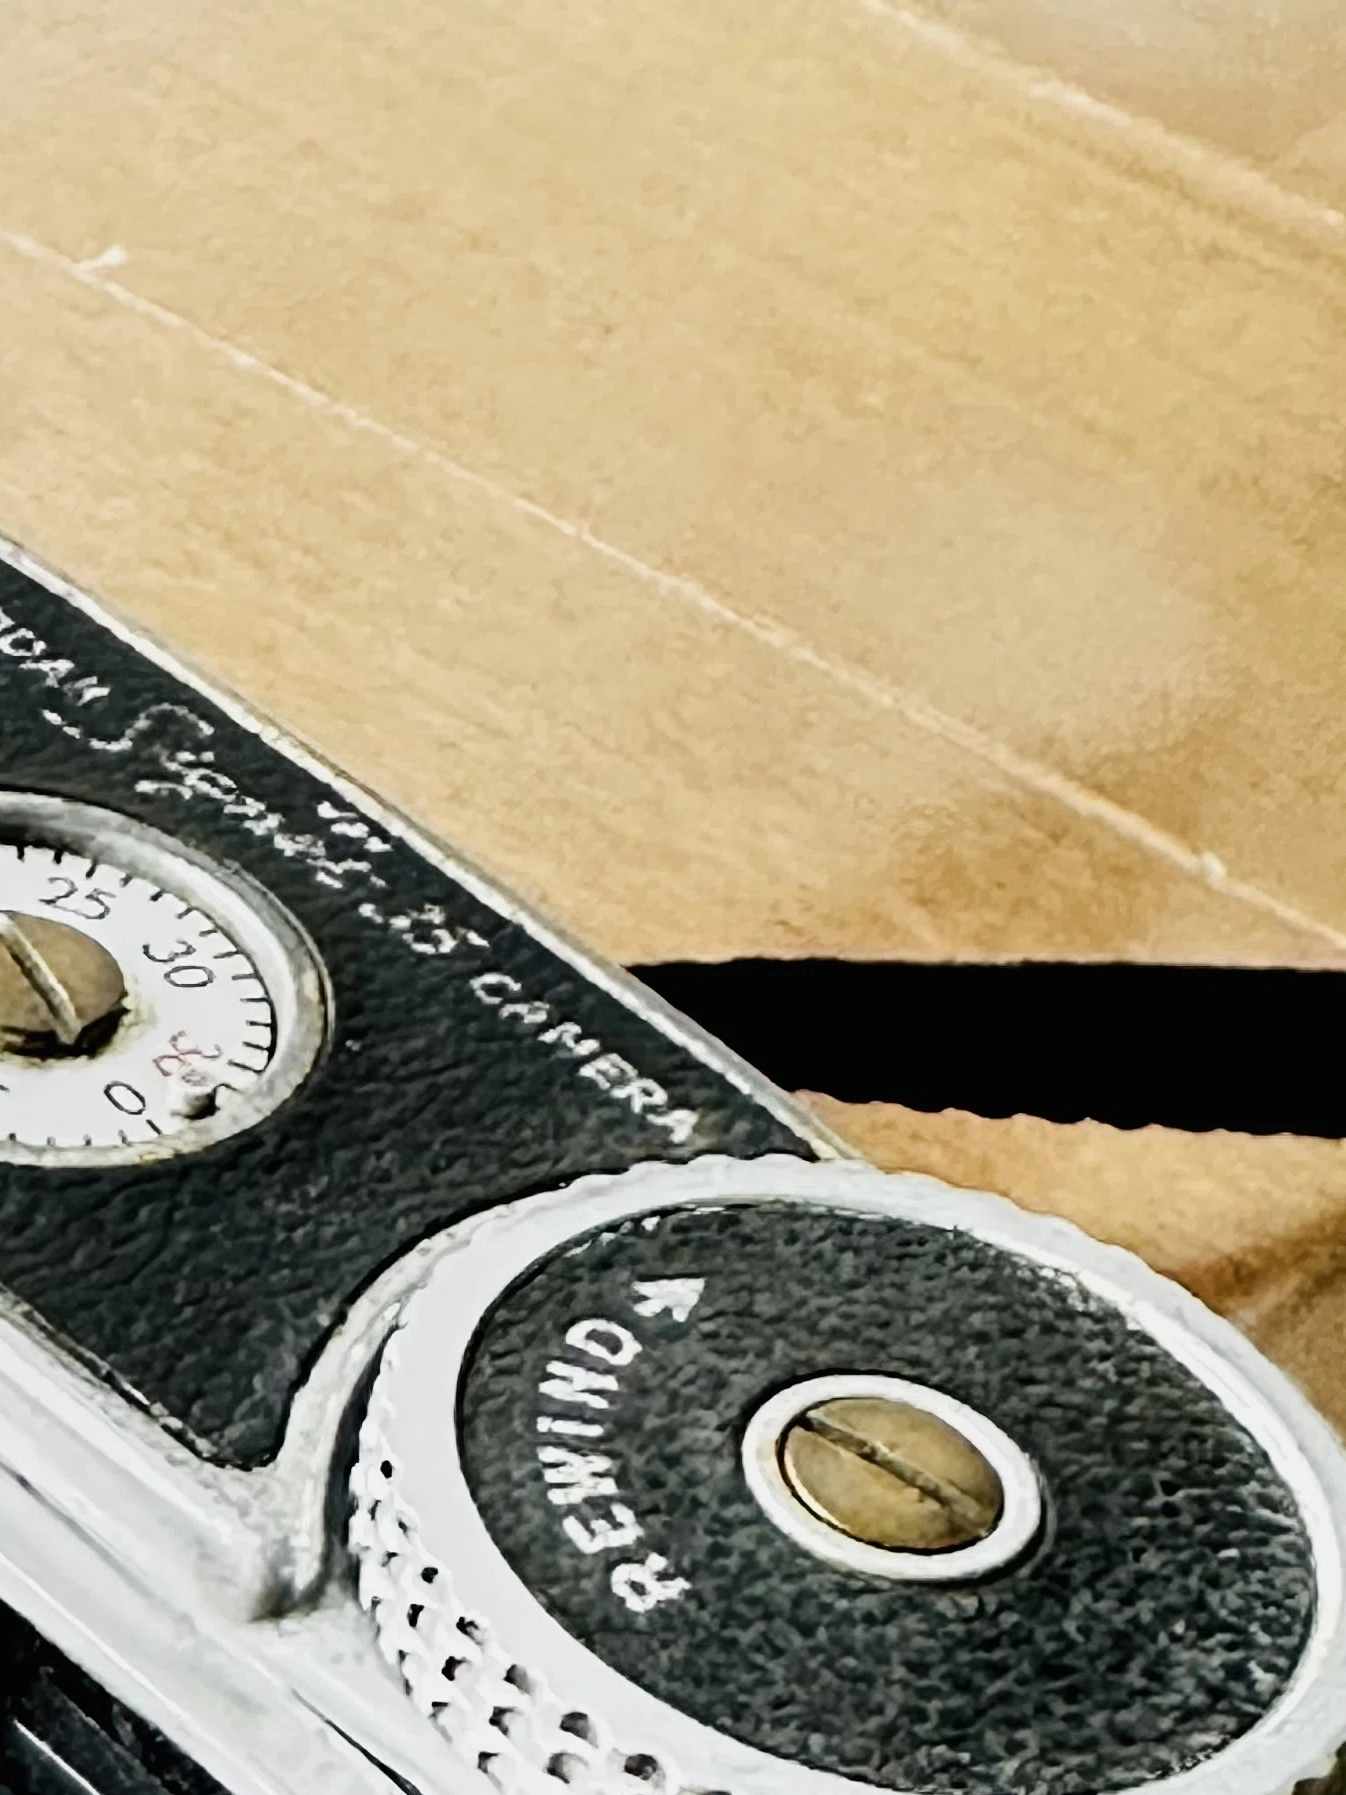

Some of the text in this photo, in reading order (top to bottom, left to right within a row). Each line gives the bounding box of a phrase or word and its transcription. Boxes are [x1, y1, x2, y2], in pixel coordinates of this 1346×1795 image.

[39, 876, 116, 920] 25
[143, 940, 215, 988] 30
[469, 972, 698, 1145] CAMERA
[103, 1081, 146, 1115] 0
[536, 1317, 692, 1613] REWIND
